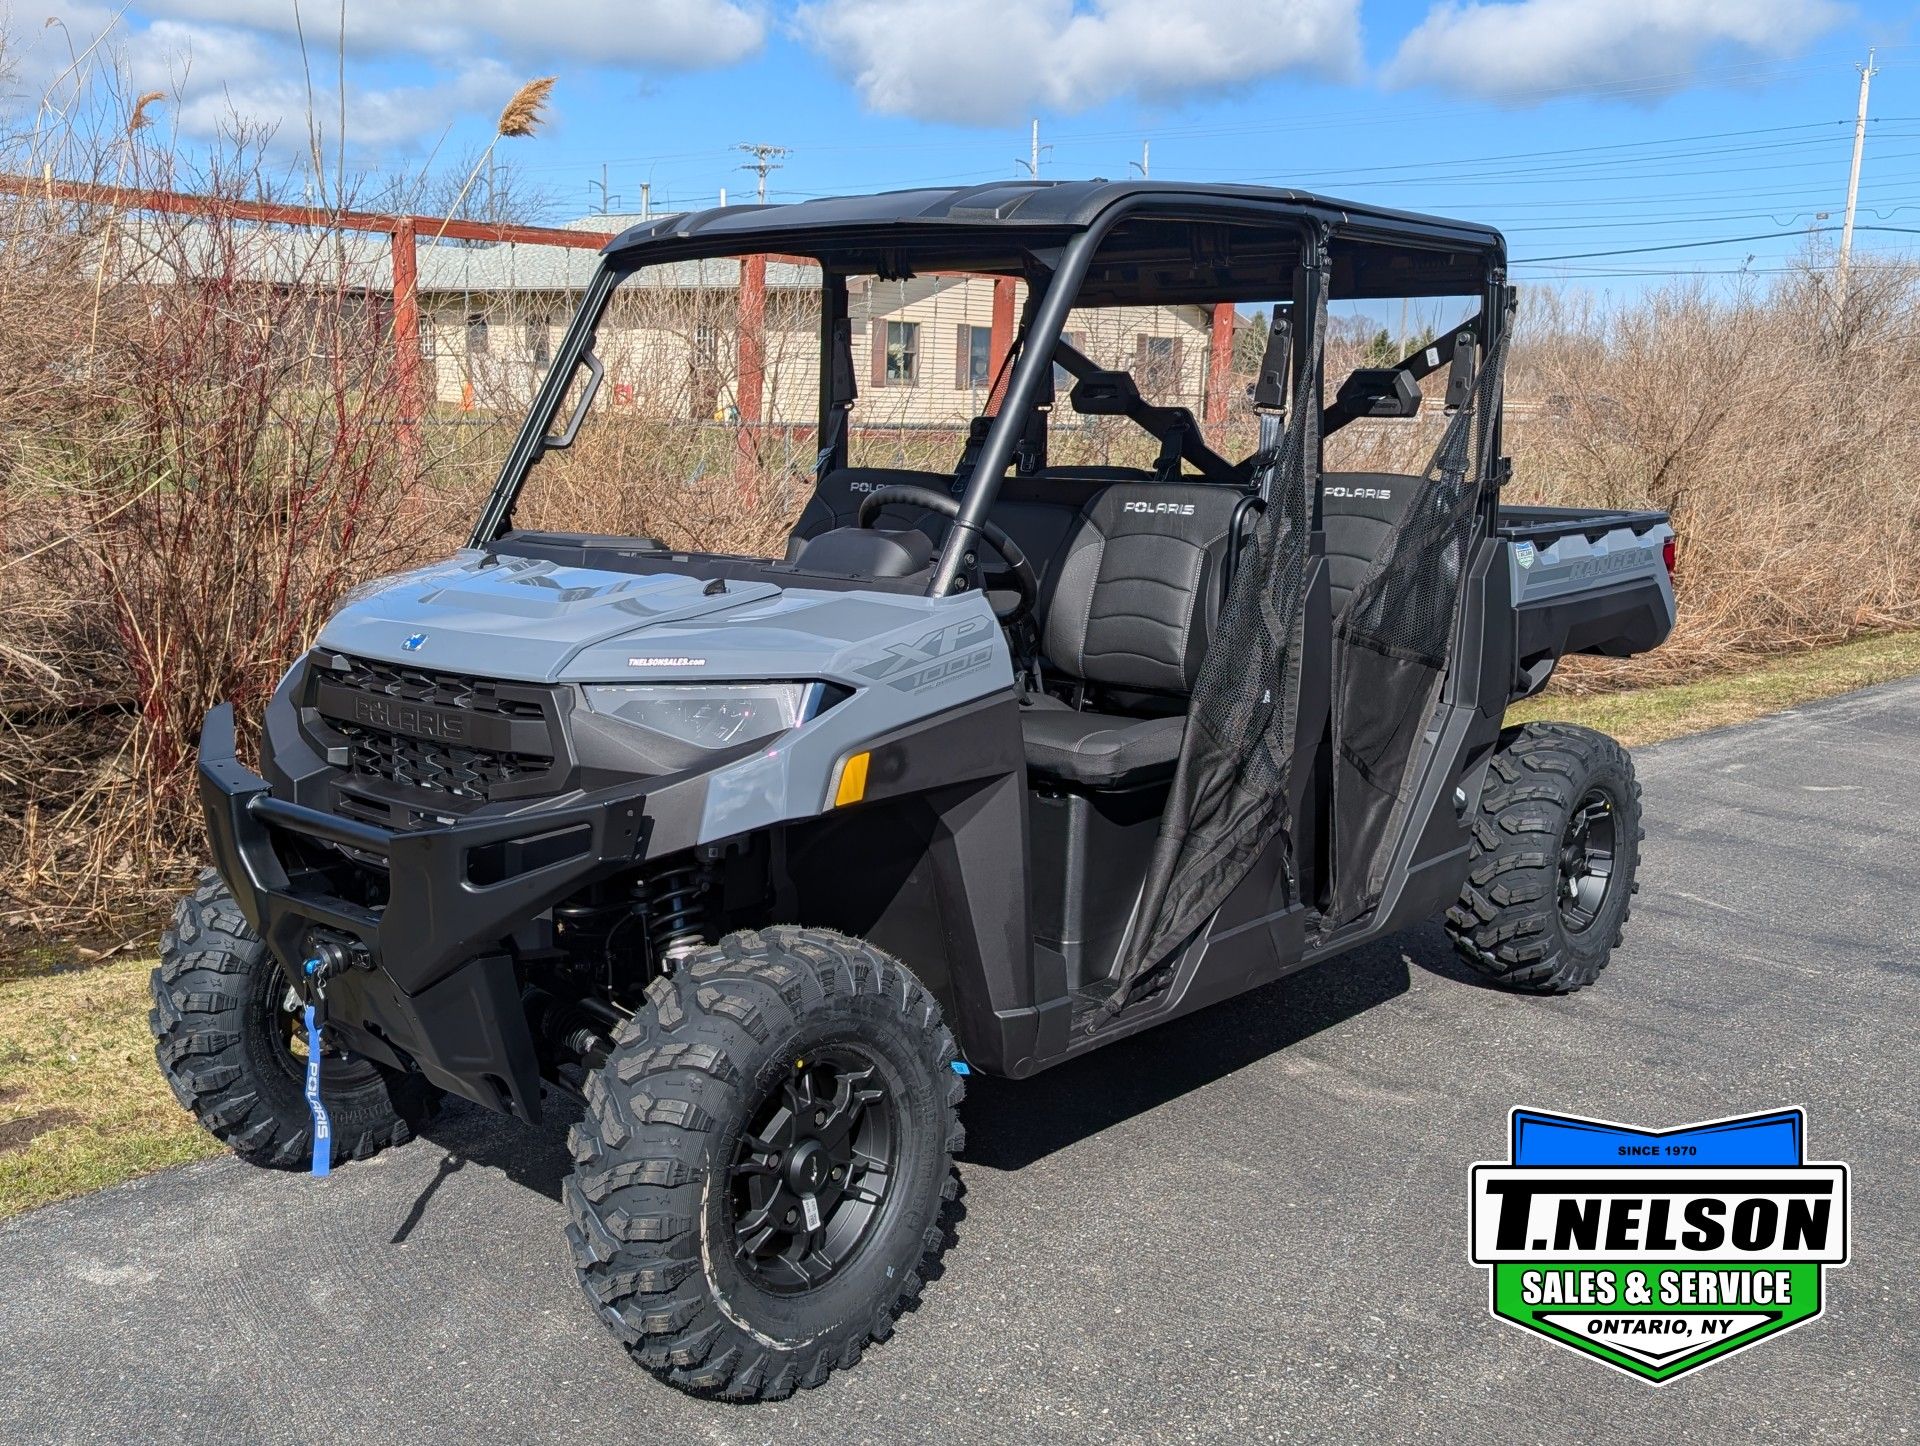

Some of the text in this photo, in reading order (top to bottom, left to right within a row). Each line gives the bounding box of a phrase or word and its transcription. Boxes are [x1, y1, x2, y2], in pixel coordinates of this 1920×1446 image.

[1123, 501, 1195, 516] POLARIS
[1323, 487, 1391, 500] POLARIS
[1569, 549, 1649, 580] RANGER
[879, 614, 990, 678] XP
[913, 645, 993, 688] 1000
[355, 695, 463, 740] POLARIS
[307, 1062, 329, 1139] POLARIS
